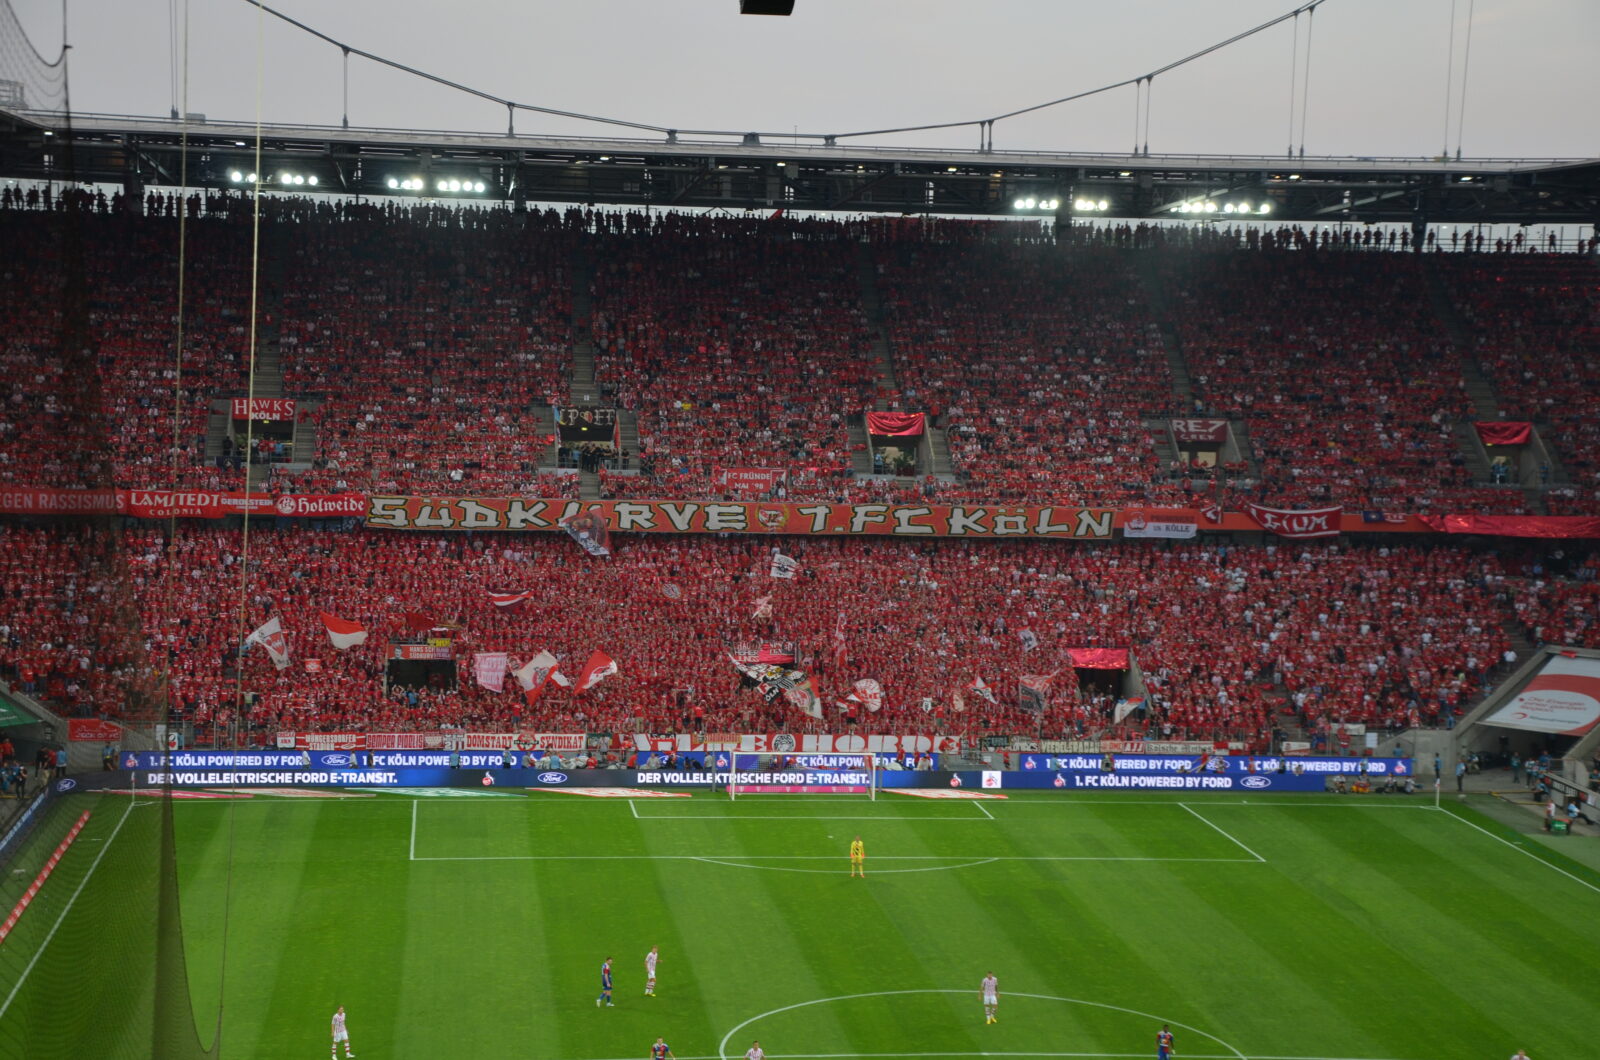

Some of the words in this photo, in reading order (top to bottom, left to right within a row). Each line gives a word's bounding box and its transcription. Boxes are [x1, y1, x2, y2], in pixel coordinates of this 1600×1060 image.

[234, 399, 295, 416] HAWKS
[251, 411, 280, 420] KÖLN
[728, 472, 738, 480] FC
[739, 470, 772, 480] FRÜNDE
[0, 493, 33, 509] GEN
[38, 493, 125, 509] RASSISMUS
[297, 496, 365, 514] Holweide
[946, 507, 1113, 537] KÖLN
[466, 735, 513, 748] DOMSTADT
[540, 735, 584, 748] SYNDIKAT
[150, 756, 159, 766] 1.
[176, 754, 206, 766] KÖLN
[208, 756, 260, 766] POWERED
[262, 756, 279, 766] BY
[281, 756, 304, 766] FOR
[326, 755, 346, 765] Ford
[373, 755, 385, 765] FC
[388, 753, 417, 765] KÖLN
[418, 755, 470, 765] POWEED
[472, 755, 486, 765] BY
[489, 755, 517, 765] FOD
[810, 755, 836, 767] KÖLN
[1070, 757, 1096, 769] KÖLN
[1149, 760, 1162, 769] BY
[1239, 760, 1248, 770] 1.
[1263, 760, 1290, 771] KÖN
[1292, 761, 1341, 772] POWERED
[1342, 762, 1357, 772] BY
[148, 773, 173, 784] DER
[175, 773, 292, 784] VOLLELEKTRISCHE
[295, 773, 329, 784] FORD
[330, 773, 398, 784] E-TRANSIT.
[543, 774, 562, 782] Ford
[637, 773, 661, 784] DER
[662, 773, 771, 784] VOLLELEKTRISCHE
[773, 773, 804, 784] FORD
[806, 773, 870, 784] E-TRANSIT.
[1075, 776, 1083, 786] 1.
[1085, 776, 1098, 786] FC
[1100, 774, 1130, 787] KÖLN
[1131, 777, 1184, 787] POWERED
[1186, 777, 1200, 787] BY
[1203, 778, 1232, 787] FORD
[1246, 778, 1266, 787] Ford
